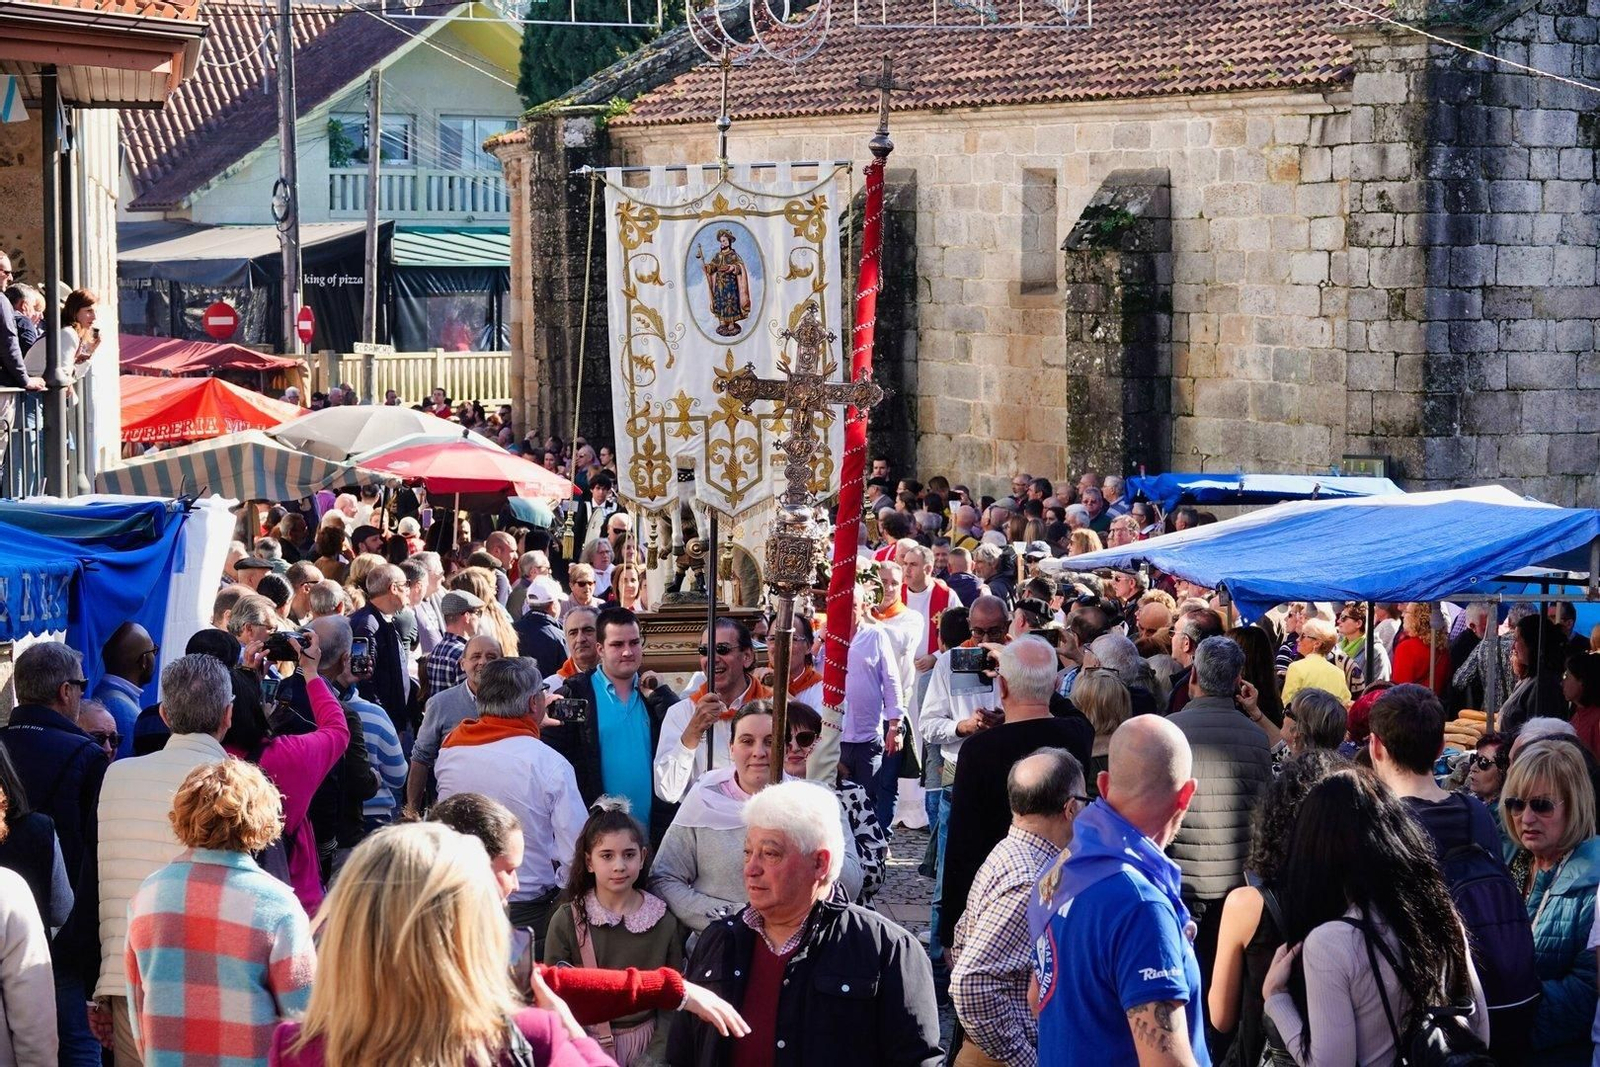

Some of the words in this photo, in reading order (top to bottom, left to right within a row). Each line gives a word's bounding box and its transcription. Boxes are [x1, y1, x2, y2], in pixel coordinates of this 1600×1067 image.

[303, 273, 326, 288] king
[327, 273, 338, 288] of
[338, 274, 364, 288] pizza
